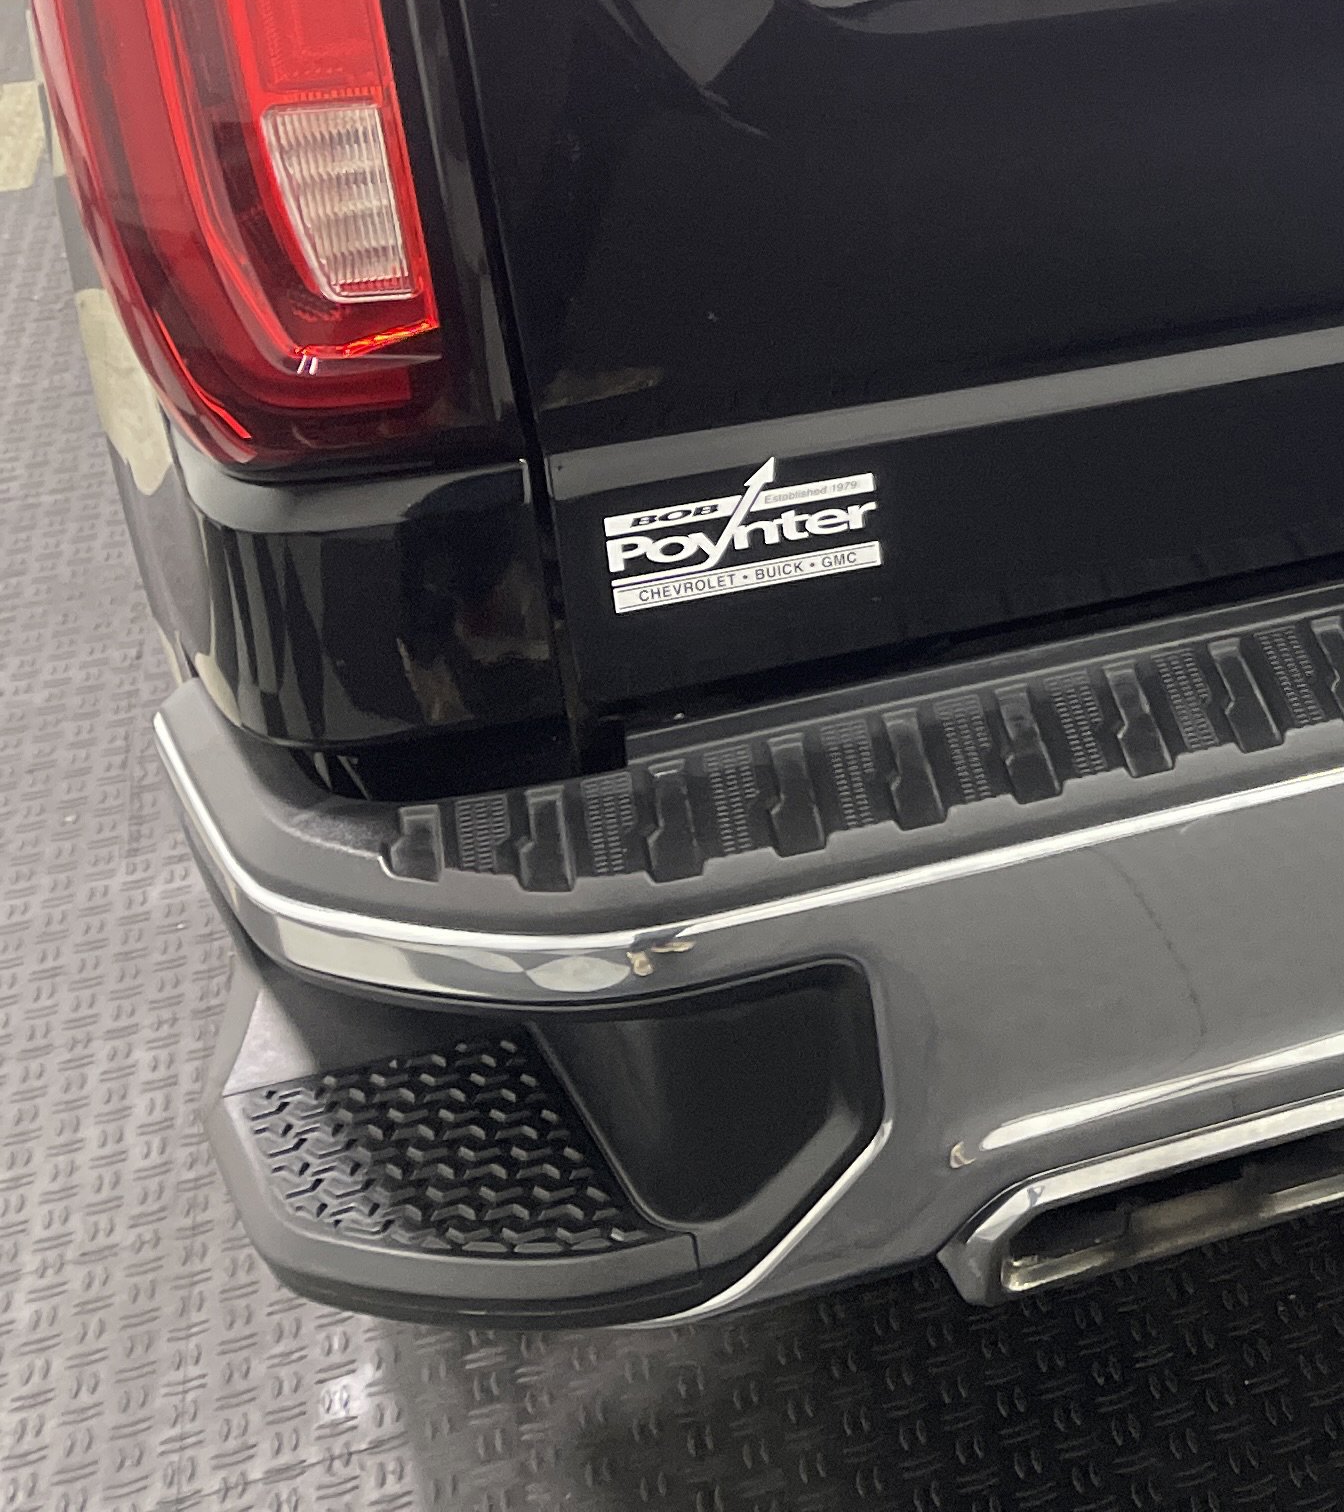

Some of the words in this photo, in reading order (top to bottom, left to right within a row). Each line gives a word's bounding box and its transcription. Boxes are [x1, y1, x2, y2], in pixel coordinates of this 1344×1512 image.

[832, 480, 858, 493] 1979
[630, 504, 719, 528] BOB
[606, 501, 877, 572] Poynter
[639, 574, 736, 602] CHEVROLET
[755, 560, 803, 581] BUICK
[822, 551, 858, 569] GMC
